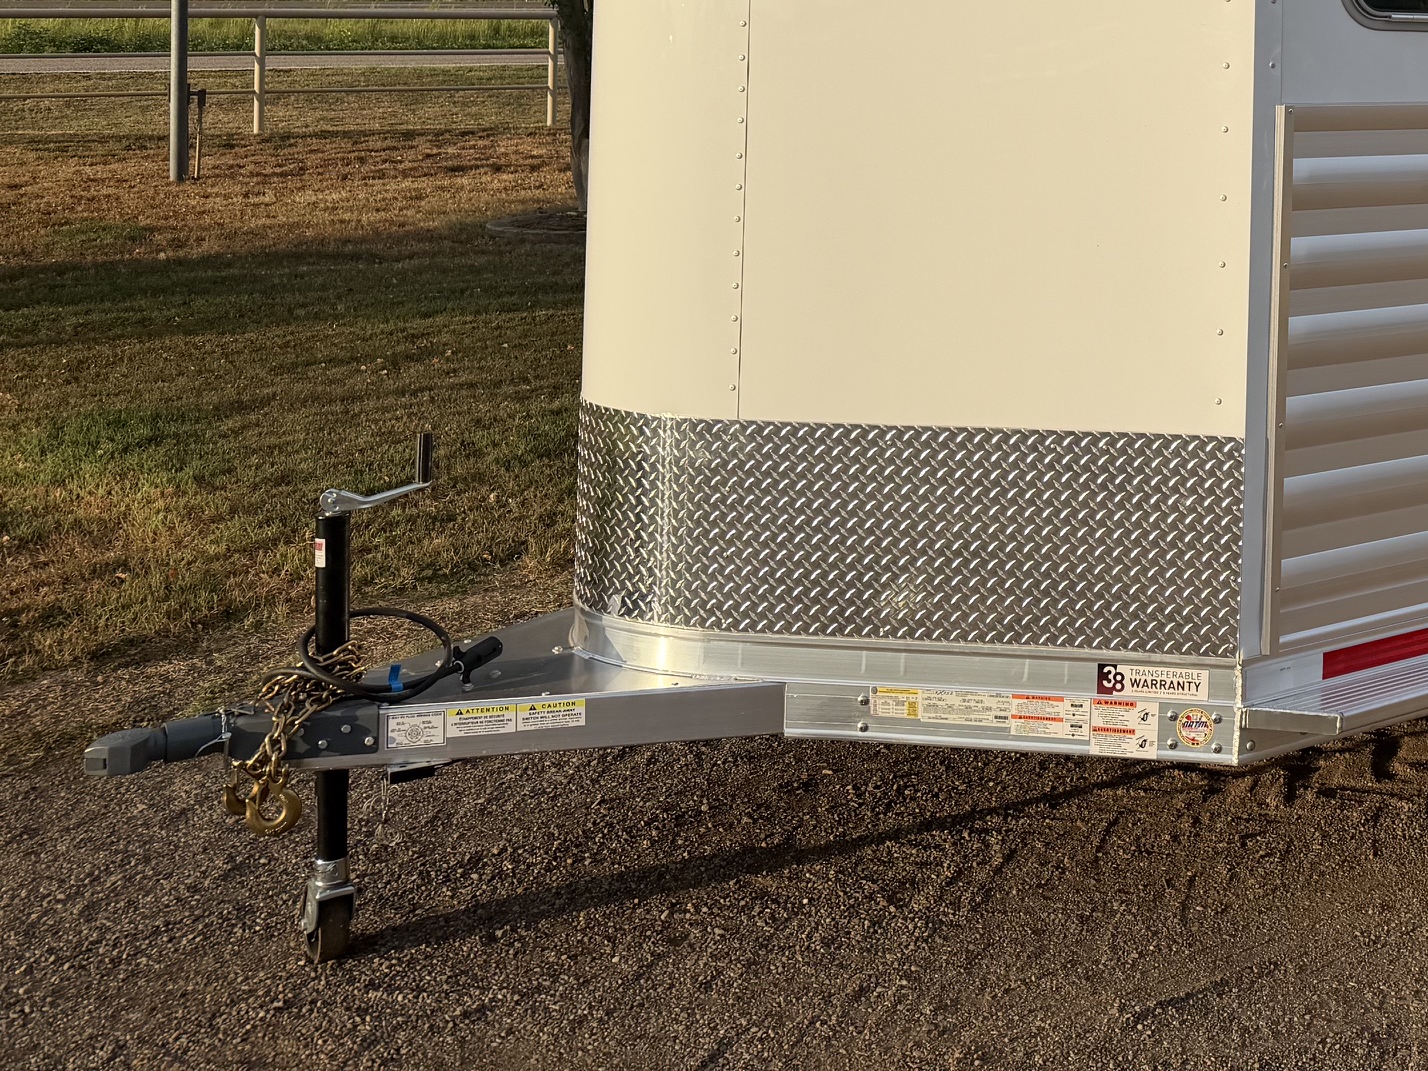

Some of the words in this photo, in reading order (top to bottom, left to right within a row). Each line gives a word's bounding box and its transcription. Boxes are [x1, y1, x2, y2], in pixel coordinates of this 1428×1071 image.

[1129, 668, 1202, 681] TRANSFERABLE
[1129, 677, 1202, 693] WARRANTY
[465, 706, 510, 715] ATTENTION
[541, 701, 576, 709] CAUTION
